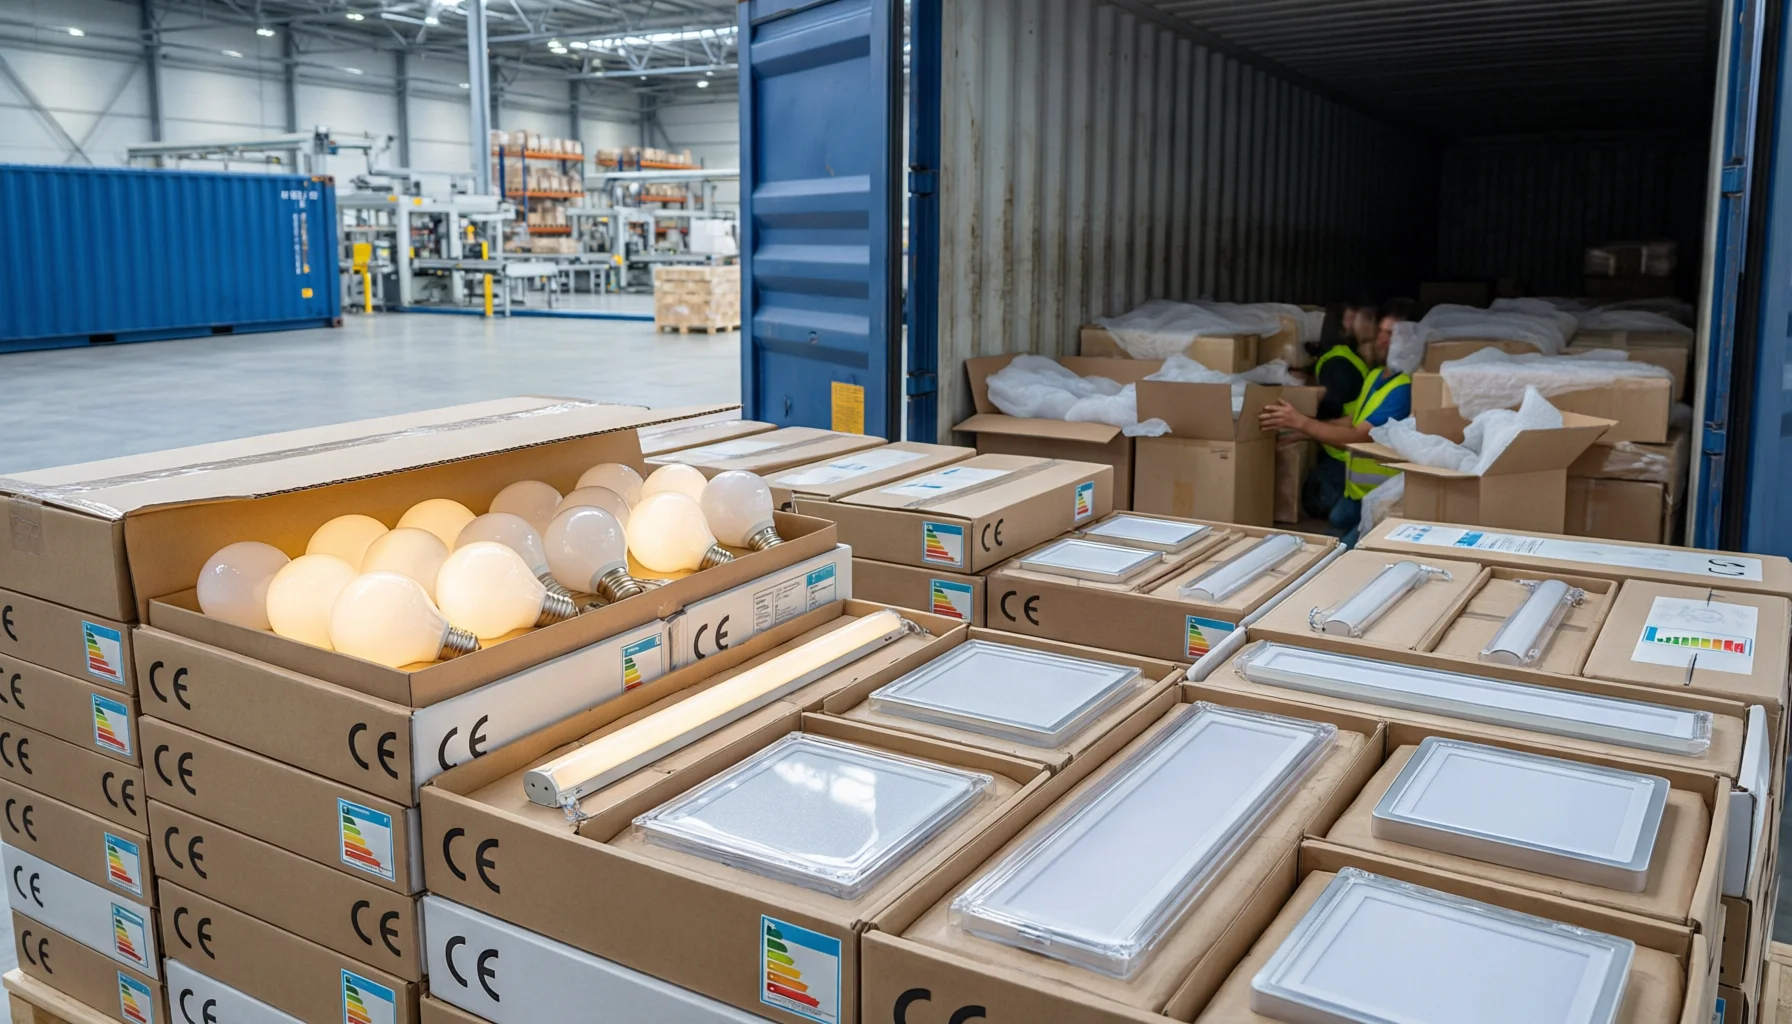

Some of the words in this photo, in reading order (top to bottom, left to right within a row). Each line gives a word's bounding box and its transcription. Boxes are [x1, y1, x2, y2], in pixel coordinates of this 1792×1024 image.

[981, 518, 1004, 552] CE
[1000, 590, 1040, 627] CE
[693, 615, 729, 660] CE
[149, 660, 191, 711] CE
[0, 731, 34, 775] CE
[348, 722, 399, 780] CE
[438, 714, 488, 771] CE
[101, 771, 137, 818] CE
[154, 744, 197, 806] CE
[5, 798, 37, 842] CE
[164, 826, 208, 881] CE
[442, 827, 501, 896] CE
[13, 865, 44, 908] CE
[21, 929, 53, 975] CE
[173, 906, 216, 960] CE
[350, 899, 402, 958] CE
[445, 935, 500, 1003] CE
